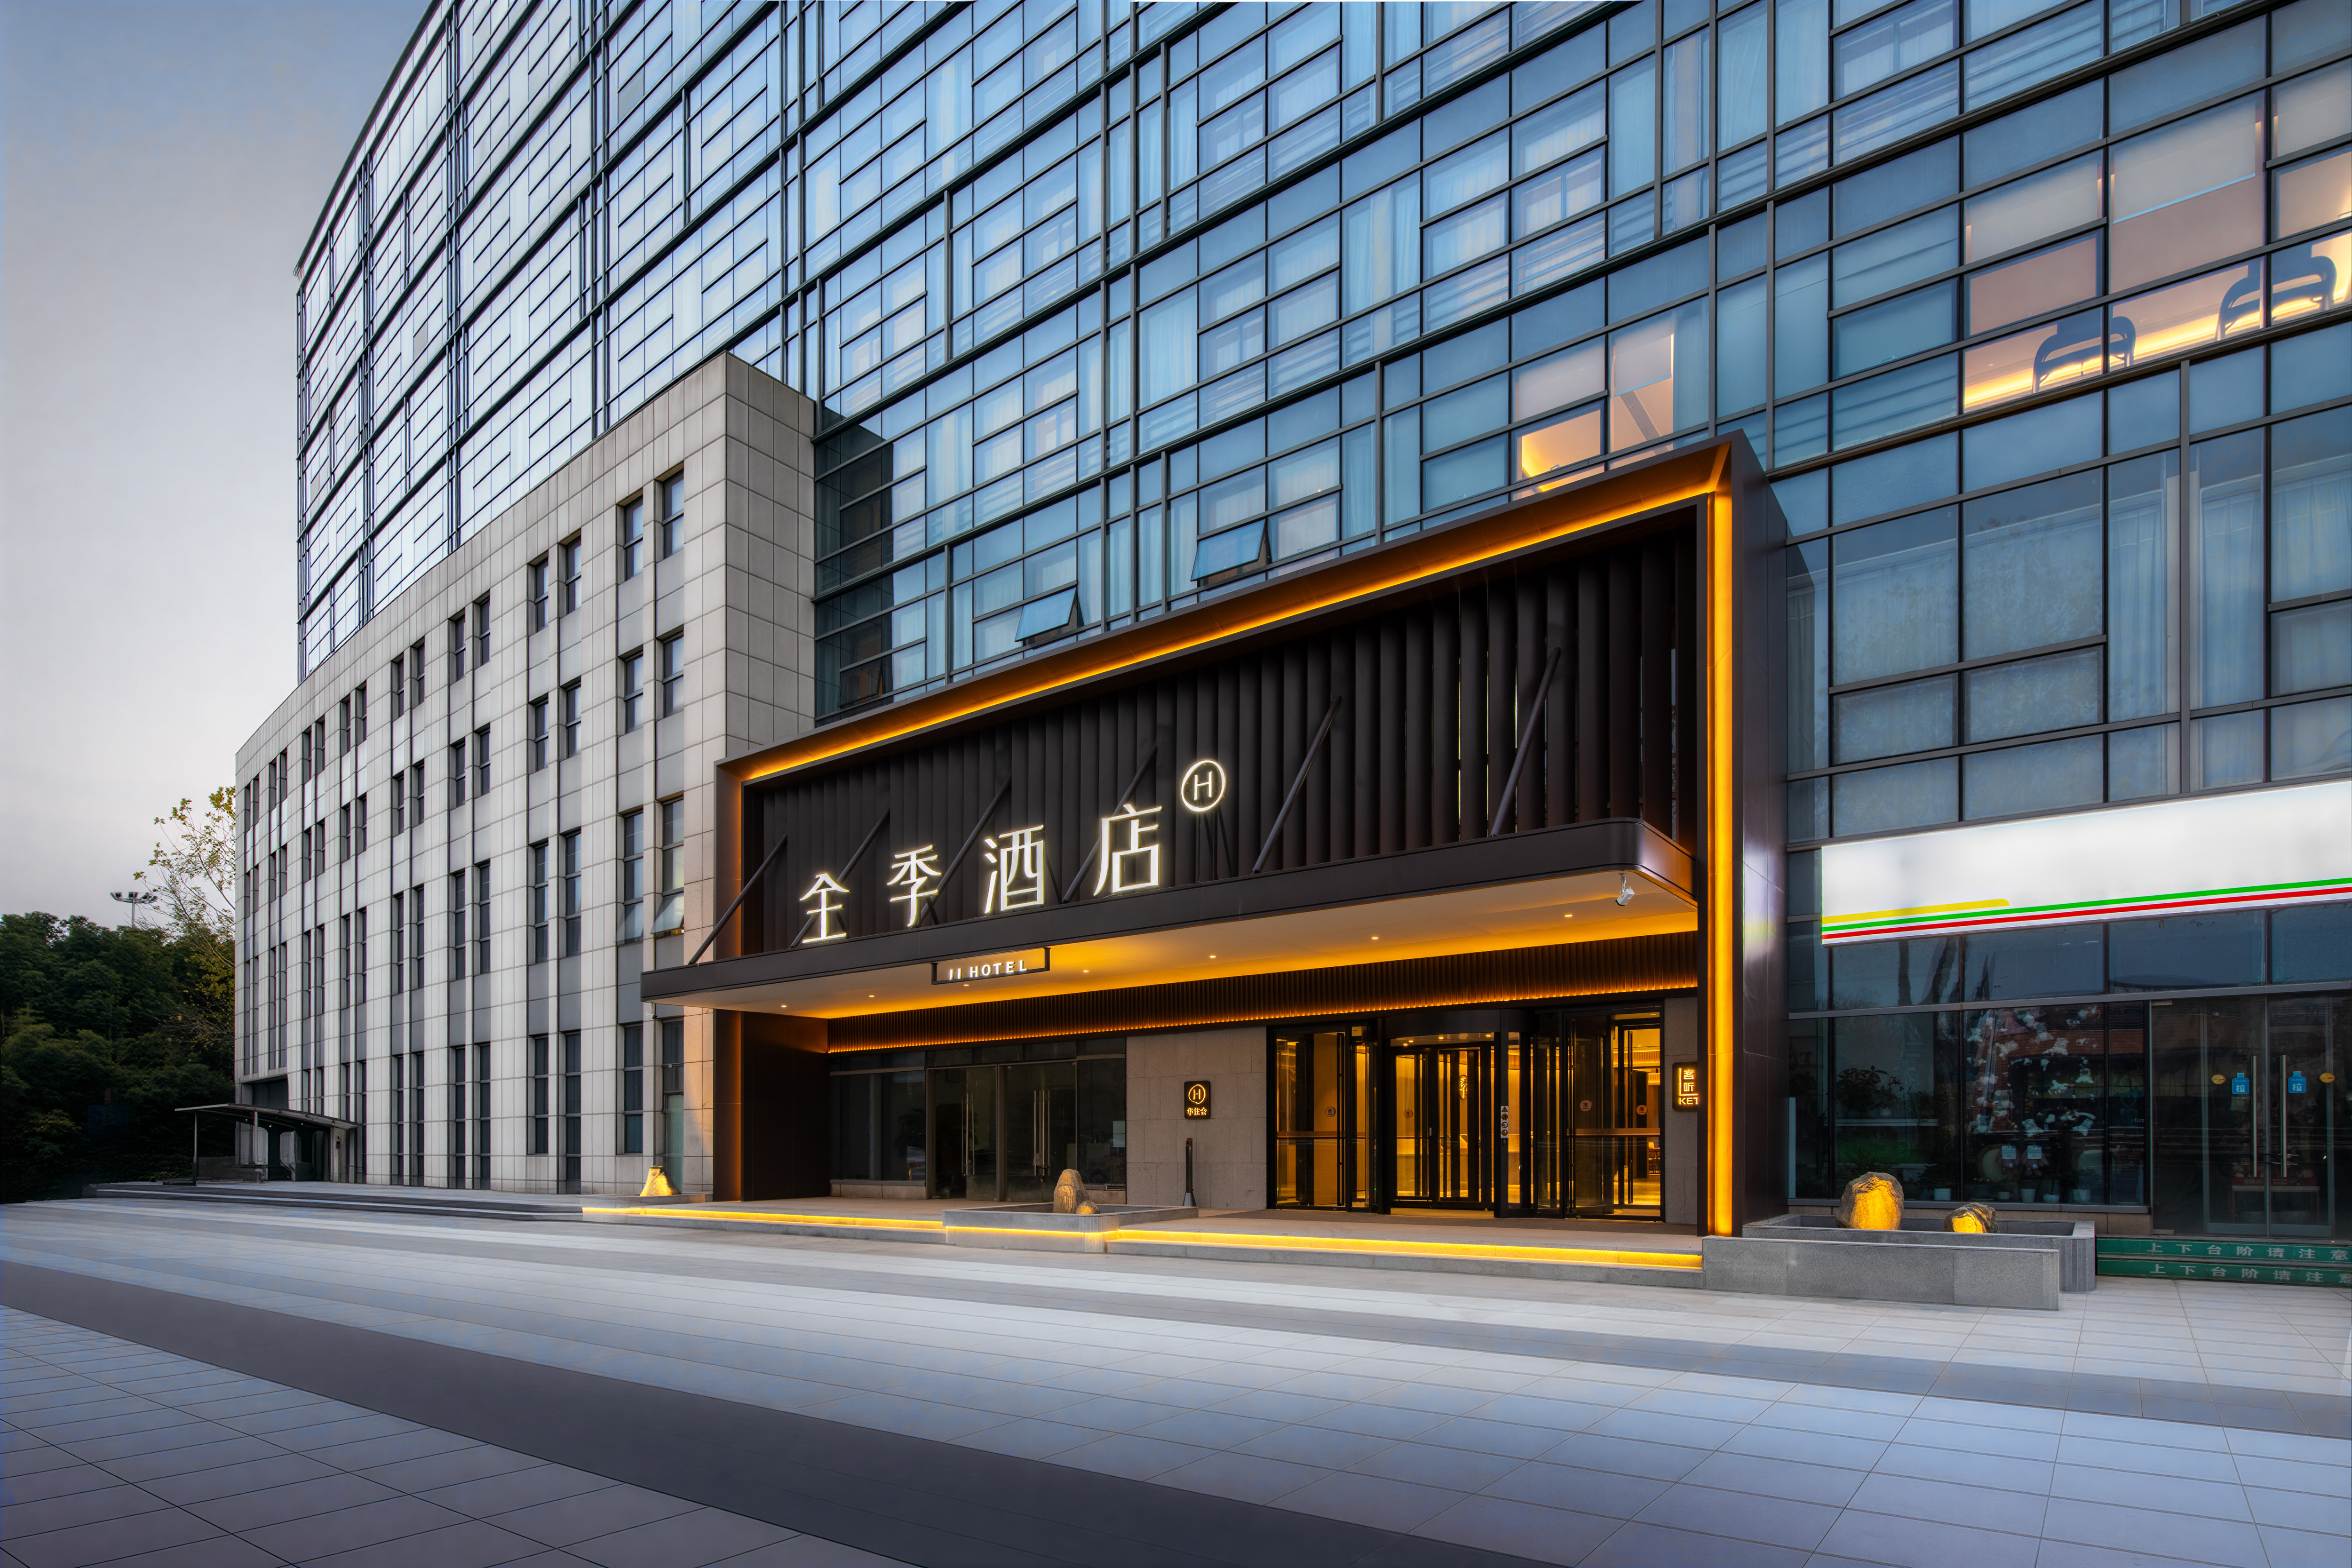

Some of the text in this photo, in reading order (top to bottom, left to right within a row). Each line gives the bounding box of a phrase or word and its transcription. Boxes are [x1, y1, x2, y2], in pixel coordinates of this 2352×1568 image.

[799, 804, 1163, 943] 全季酒店
[949, 960, 1027, 980] JI HOTEL
[2235, 1084, 2245, 1092] 拉
[2292, 1083, 2302, 1091] 拉
[1187, 1107, 1207, 1116] 华住会
[2146, 1242, 2349, 1261] 上下台阶请注意
